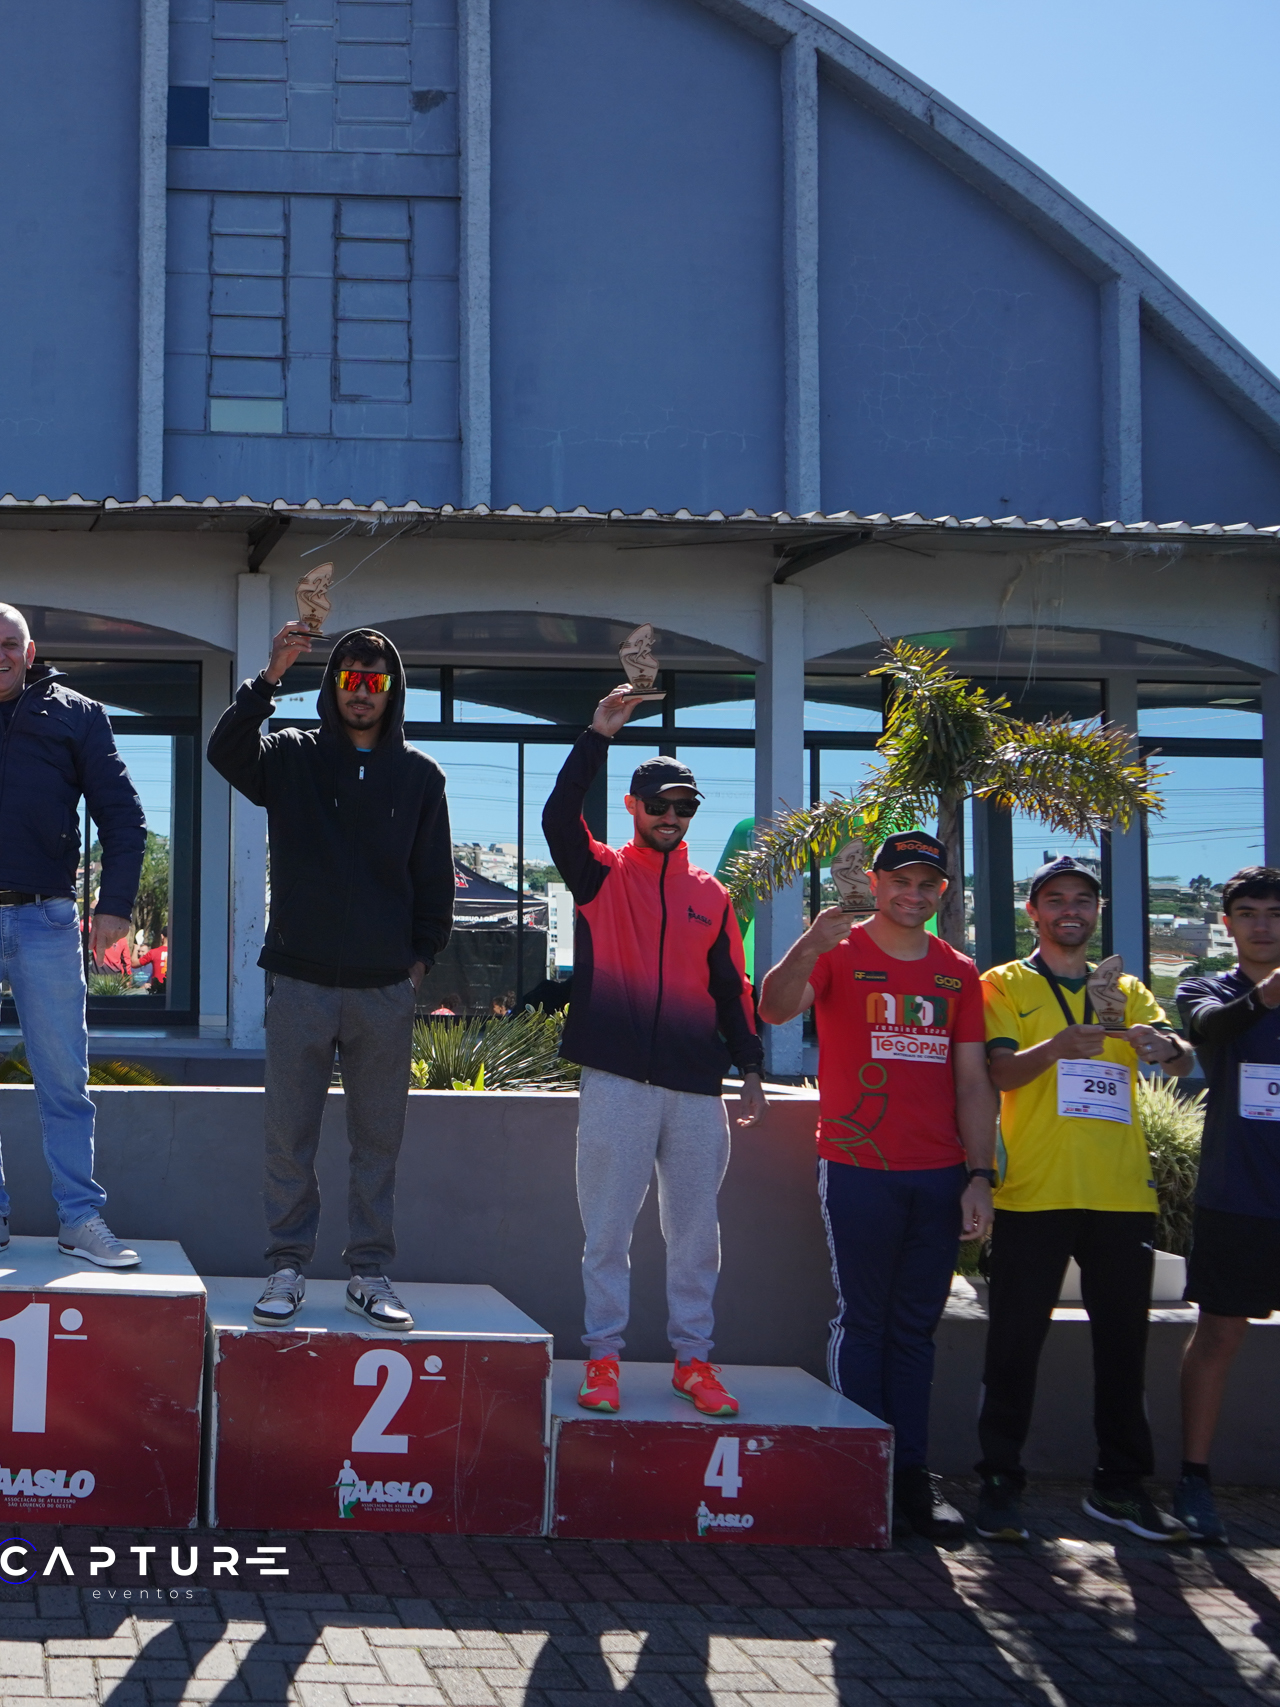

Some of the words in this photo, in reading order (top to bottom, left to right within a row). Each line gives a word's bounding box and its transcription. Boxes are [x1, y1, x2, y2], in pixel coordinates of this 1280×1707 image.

[875, 1024, 918, 1034] running
[924, 1026, 947, 1035] team
[1084, 1079, 1117, 1096] 298
[350, 1480, 433, 1504] AASLO
